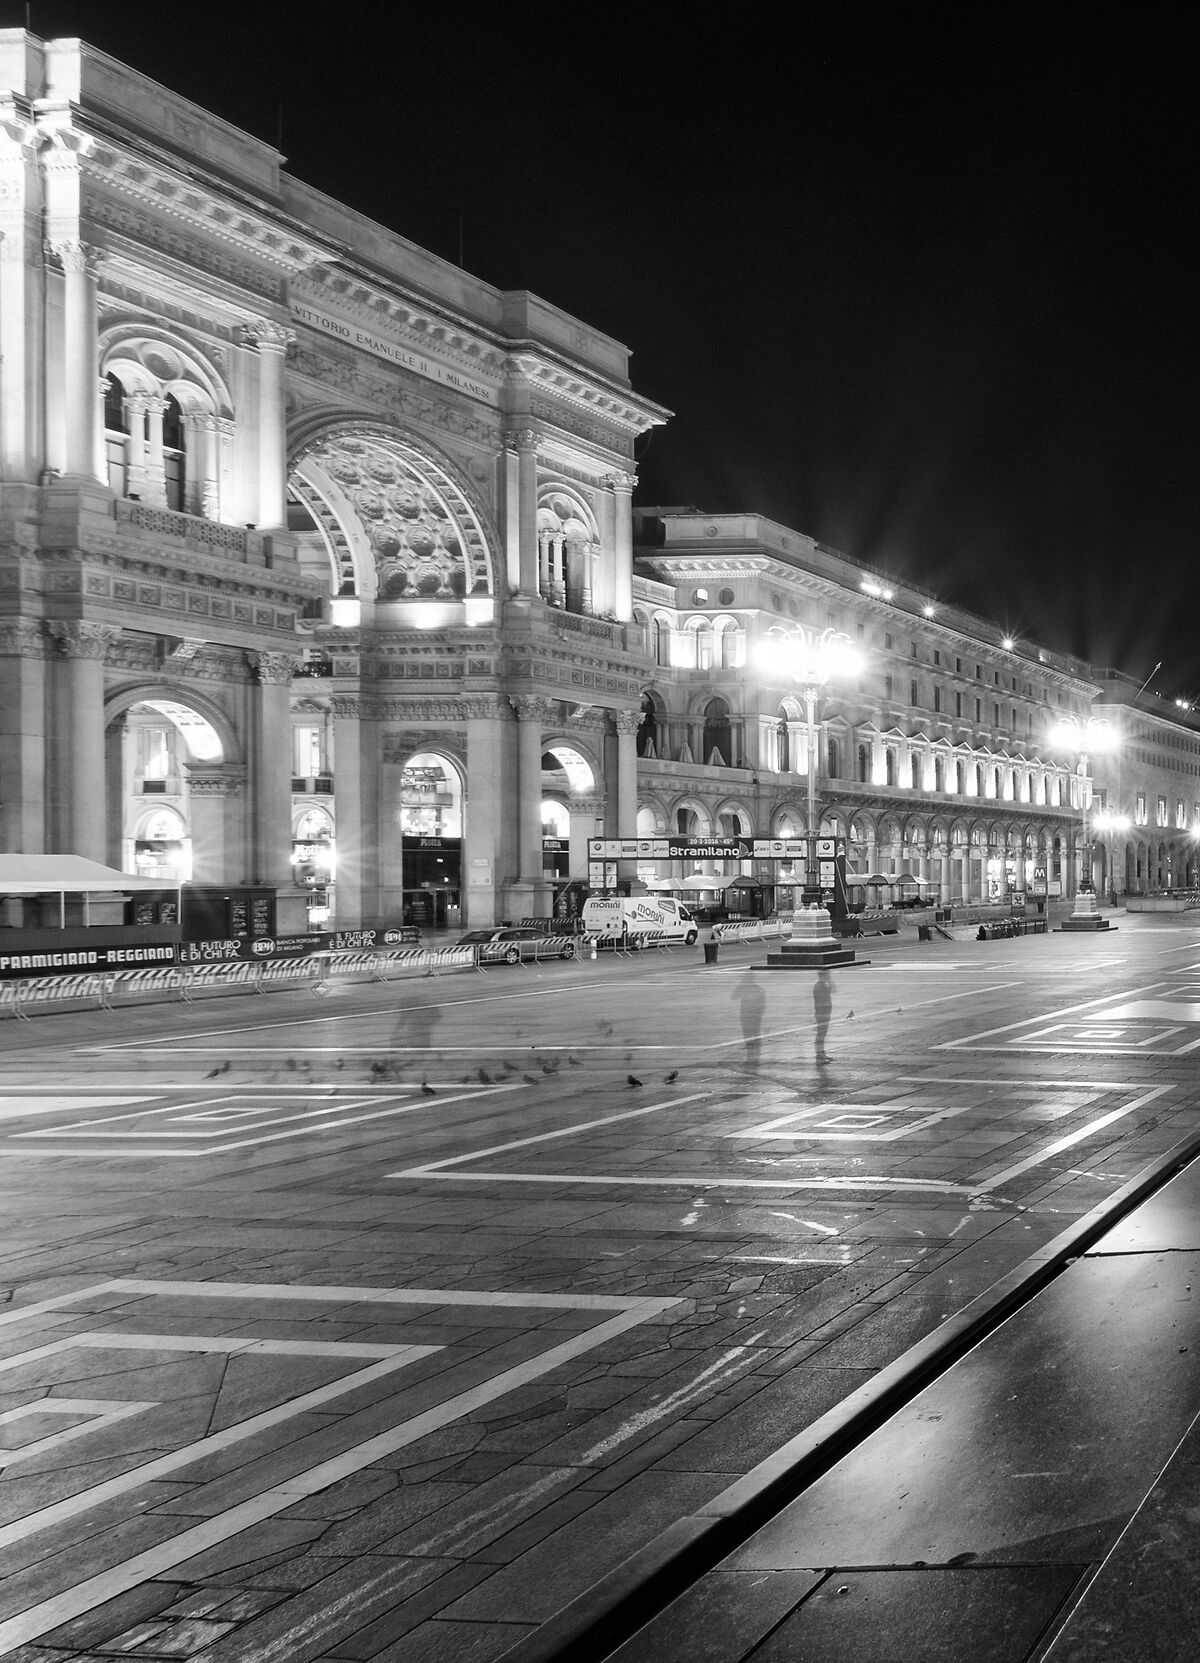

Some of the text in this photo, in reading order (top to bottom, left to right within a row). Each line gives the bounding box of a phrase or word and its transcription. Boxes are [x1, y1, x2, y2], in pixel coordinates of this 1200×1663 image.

[294, 305, 350, 337] VITTORIO
[356, 333, 415, 366] EMANUELE
[446, 373, 490, 398] MILANESI
[669, 846, 740, 856] Stramilano
[1035, 868, 1046, 878] M
[345, 930, 376, 940] FUTURO
[190, 940, 241, 952] IL FUTURO
[337, 940, 346, 948] DI
[347, 939, 361, 947] CHI
[0, 948, 174, 969] PARMIGIANO-REGGIANO
[181, 949, 188, 961] È
[190, 951, 201, 960] DI
[204, 950, 223, 959] CHI
